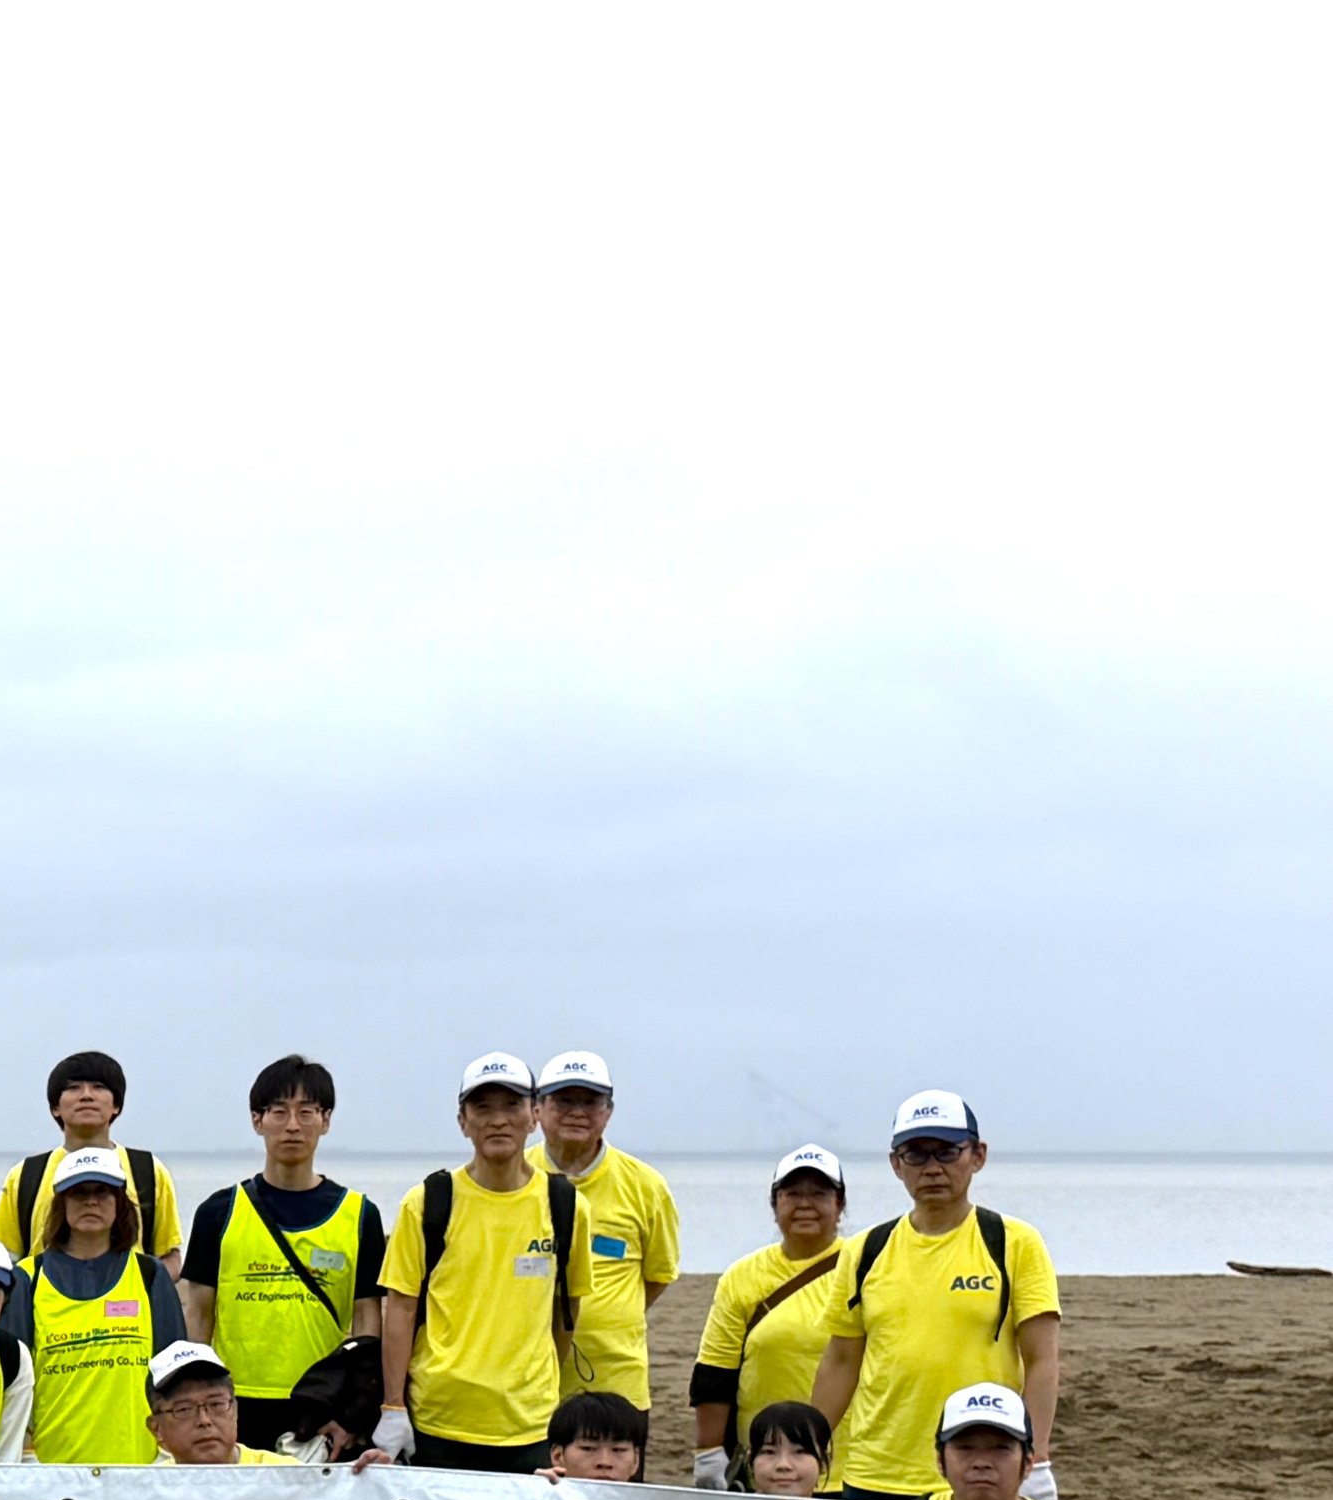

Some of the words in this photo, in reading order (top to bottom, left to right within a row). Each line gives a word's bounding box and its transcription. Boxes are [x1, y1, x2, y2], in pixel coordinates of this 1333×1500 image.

[482, 1063, 508, 1072] AGC
[564, 1062, 588, 1072] AGC
[913, 1106, 939, 1117] AGC
[794, 1151, 823, 1161] AGC
[527, 1239, 554, 1253] AG
[950, 1275, 995, 1291] AGC
[235, 1291, 256, 1301] AGC
[966, 1394, 1003, 1409] AGC
